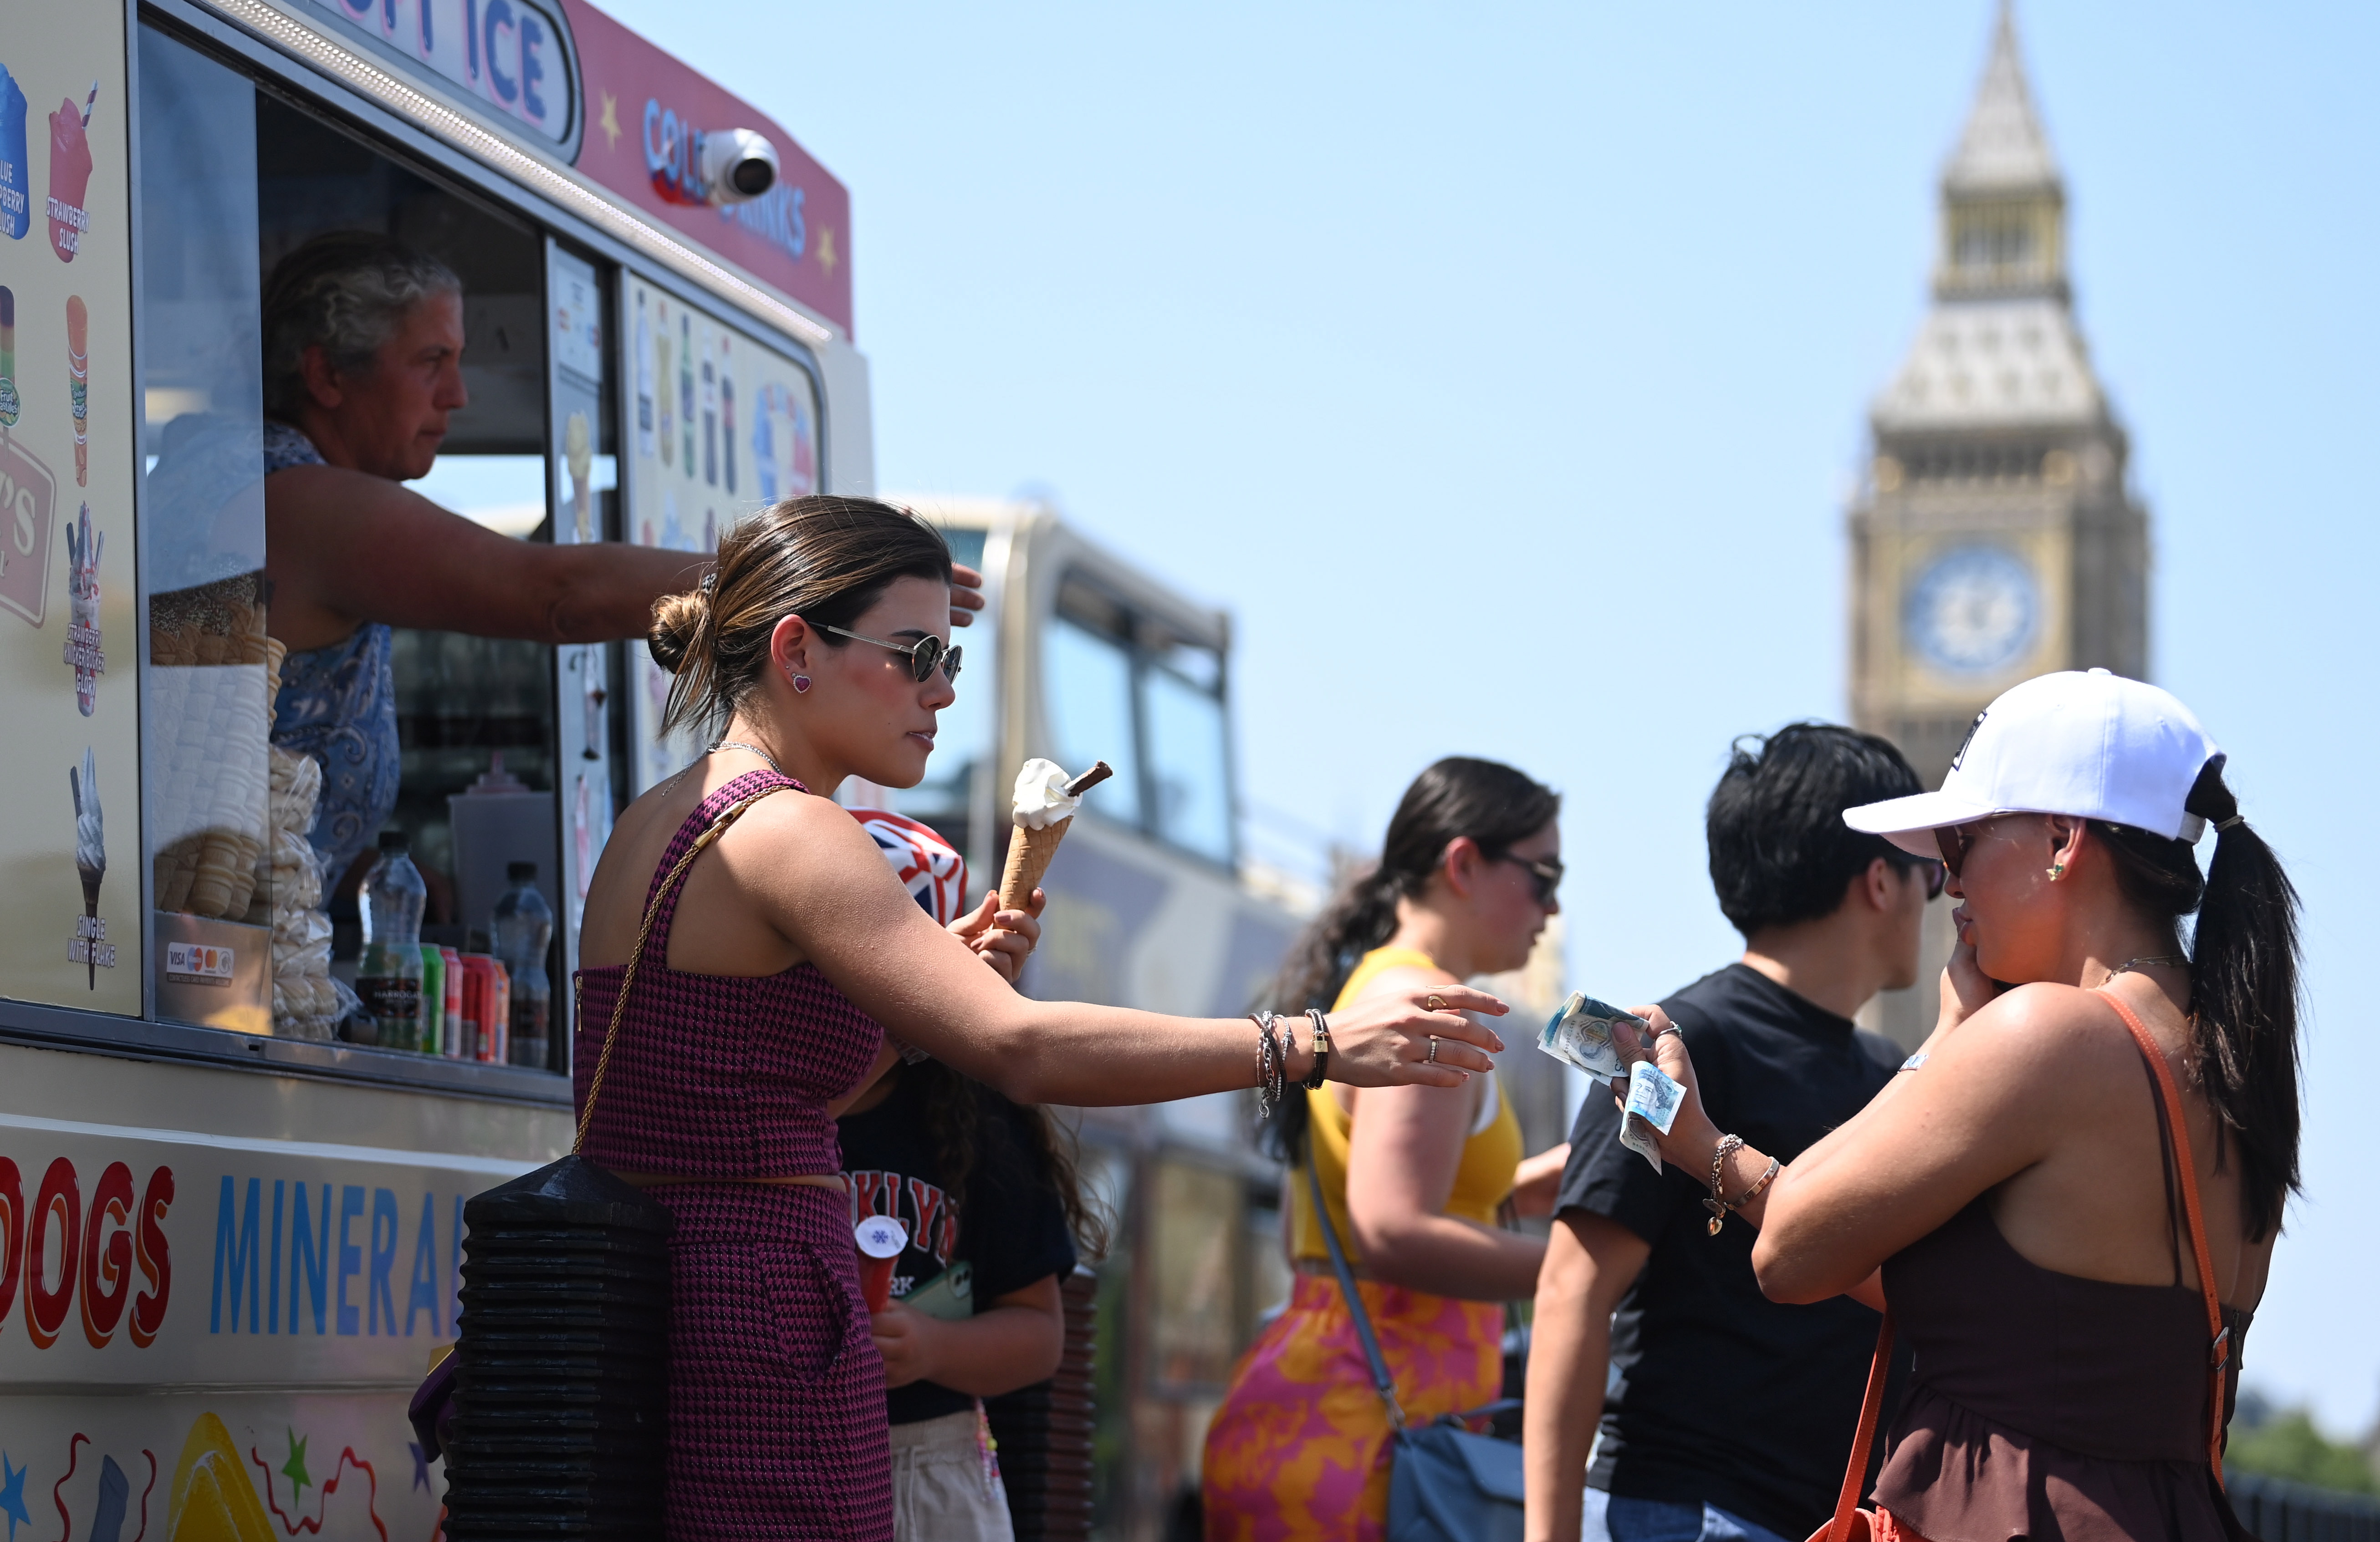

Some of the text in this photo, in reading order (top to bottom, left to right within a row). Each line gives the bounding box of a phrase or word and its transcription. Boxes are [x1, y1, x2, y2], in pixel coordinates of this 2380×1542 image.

[465, 0, 545, 127] ICE
[46, 195, 90, 234] STRAWBERRY
[59, 228, 79, 254] SLUSH
[0, 390, 13, 402] Fruit
[68, 623, 102, 648] STRAWBERRY
[63, 642, 105, 675] KNICKER BOCKER
[76, 672, 97, 697] GLORY
[77, 914, 105, 941] SINGLE
[68, 938, 115, 968] WITH FLAKE
[170, 951, 185, 966] VISA
